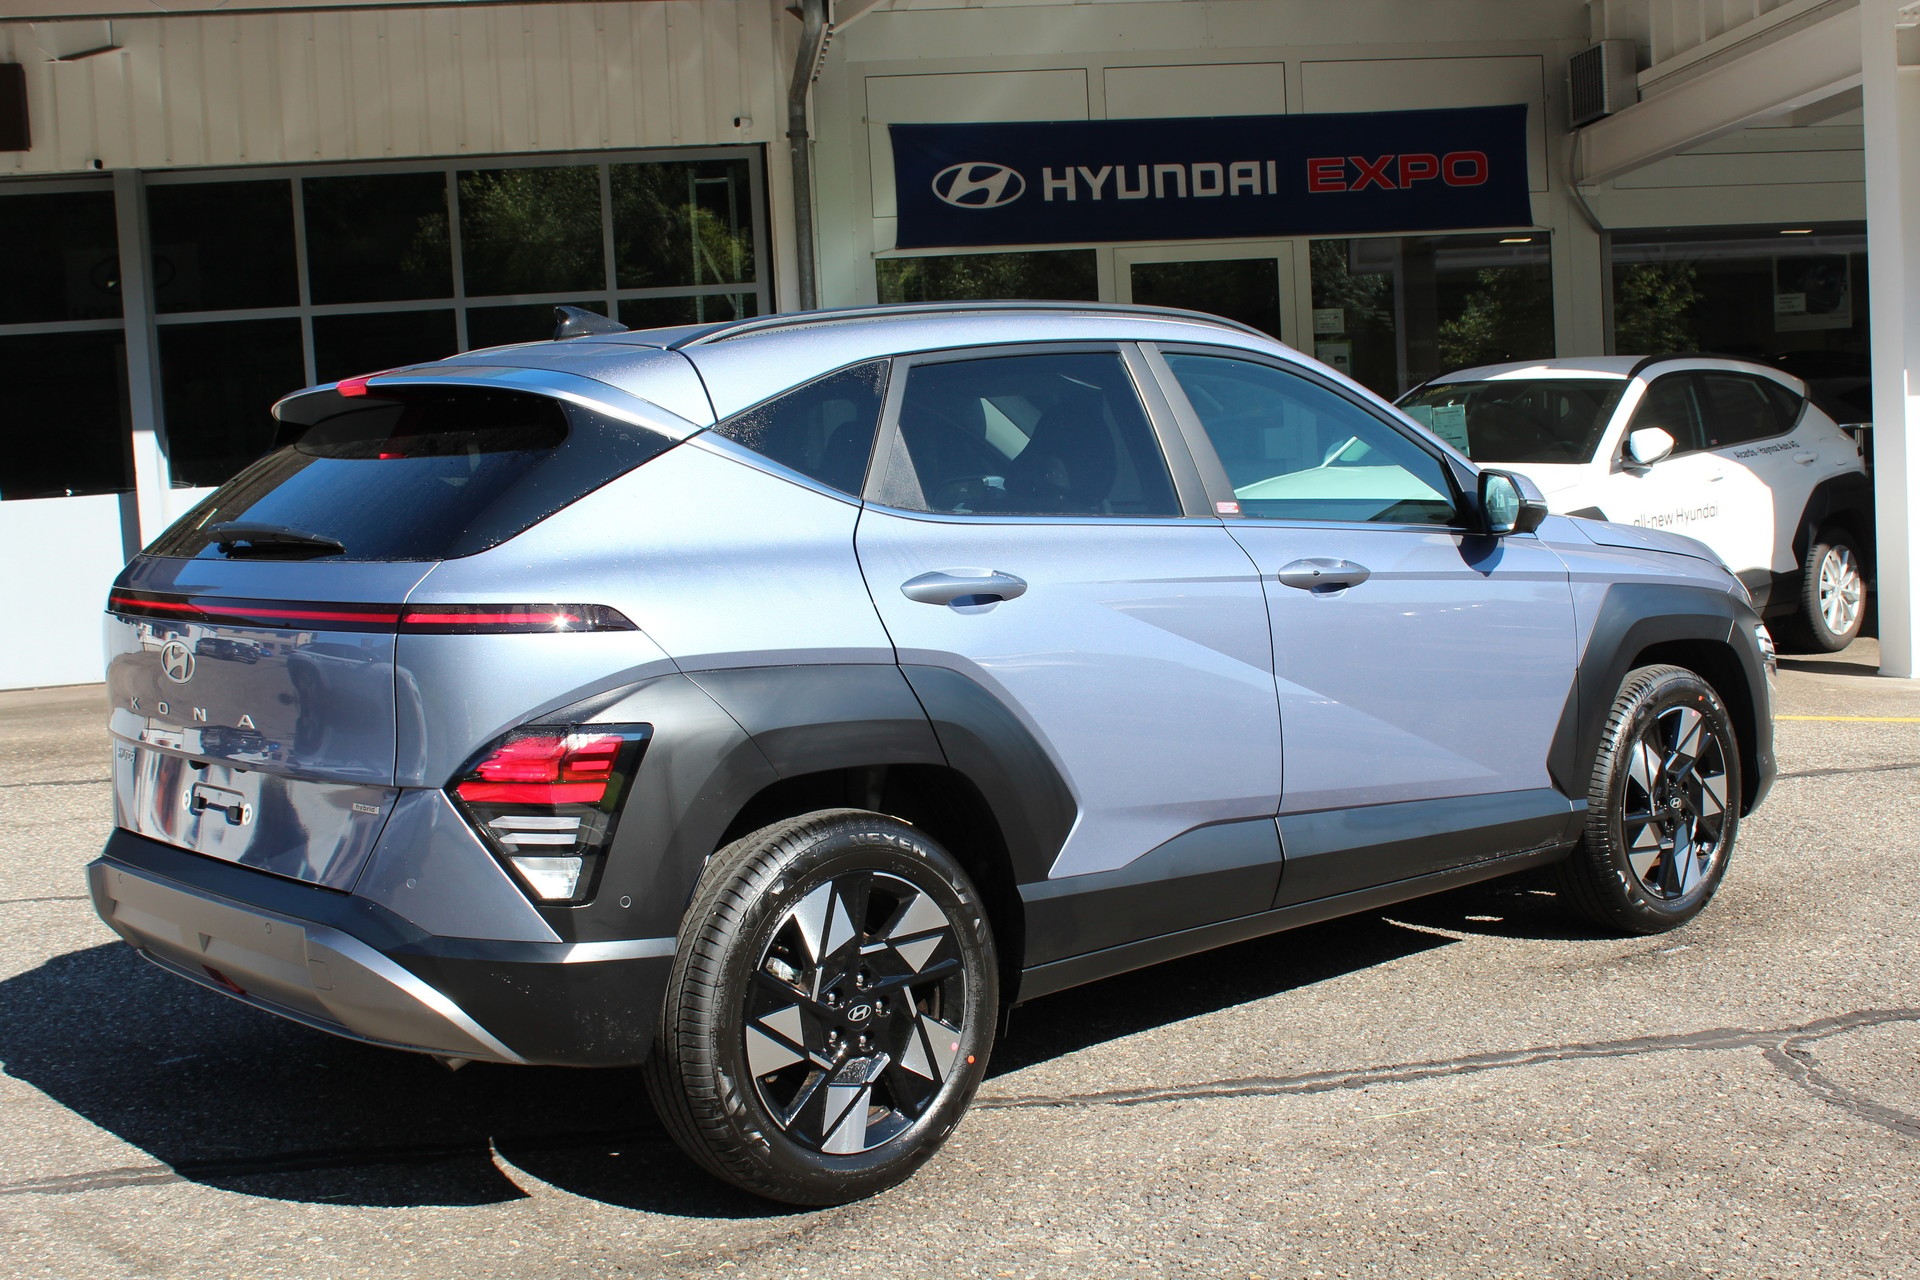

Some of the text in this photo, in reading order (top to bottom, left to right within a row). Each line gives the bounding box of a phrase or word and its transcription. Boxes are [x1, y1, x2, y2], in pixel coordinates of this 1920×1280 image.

[1042, 151, 1488, 200] HYUNDAI EXPO
[1676, 500, 1718, 526] Hyundai
[130, 696, 256, 730] KONA
[355, 803, 376, 813] hybrid
[848, 832, 927, 858] NEXEN
